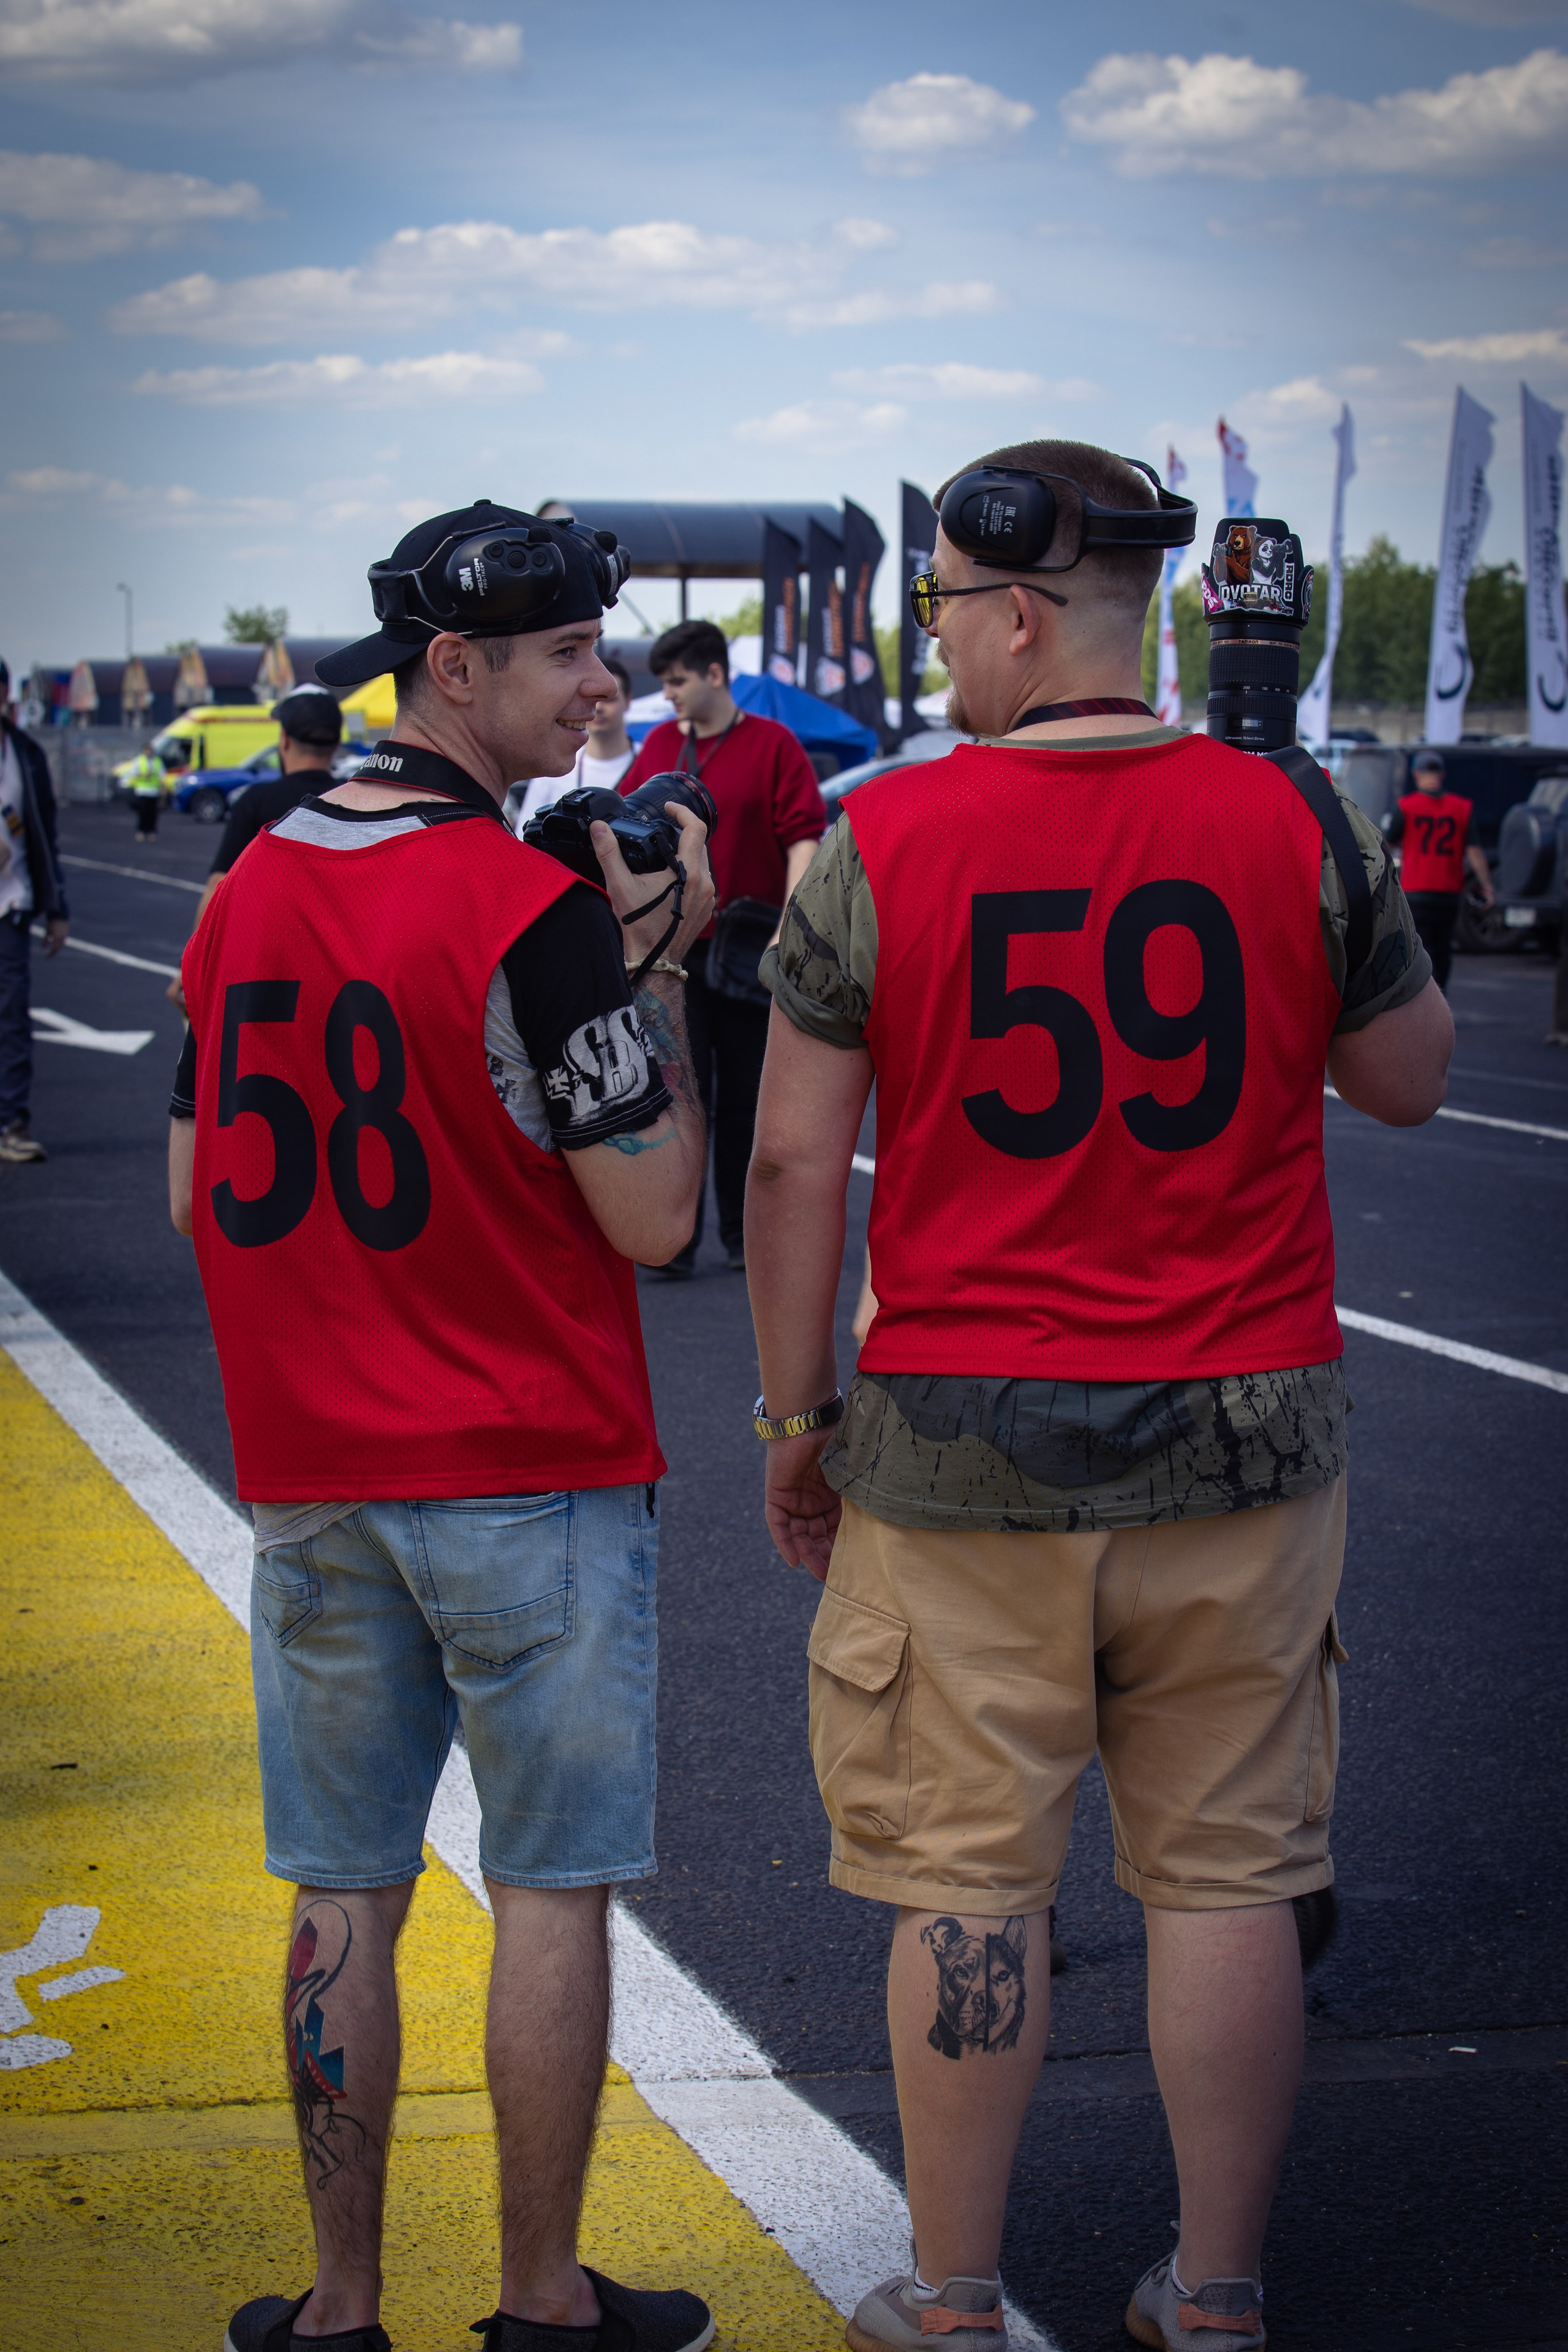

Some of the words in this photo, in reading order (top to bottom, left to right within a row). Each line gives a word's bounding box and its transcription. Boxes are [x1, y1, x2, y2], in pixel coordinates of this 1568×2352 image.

[459, 567, 473, 591] 3M
[474, 558, 485, 595] PELTOR
[360, 753, 404, 772] anon
[1415, 816, 1456, 855] 72
[961, 879, 1246, 1159] 59
[211, 980, 431, 1251] 58
